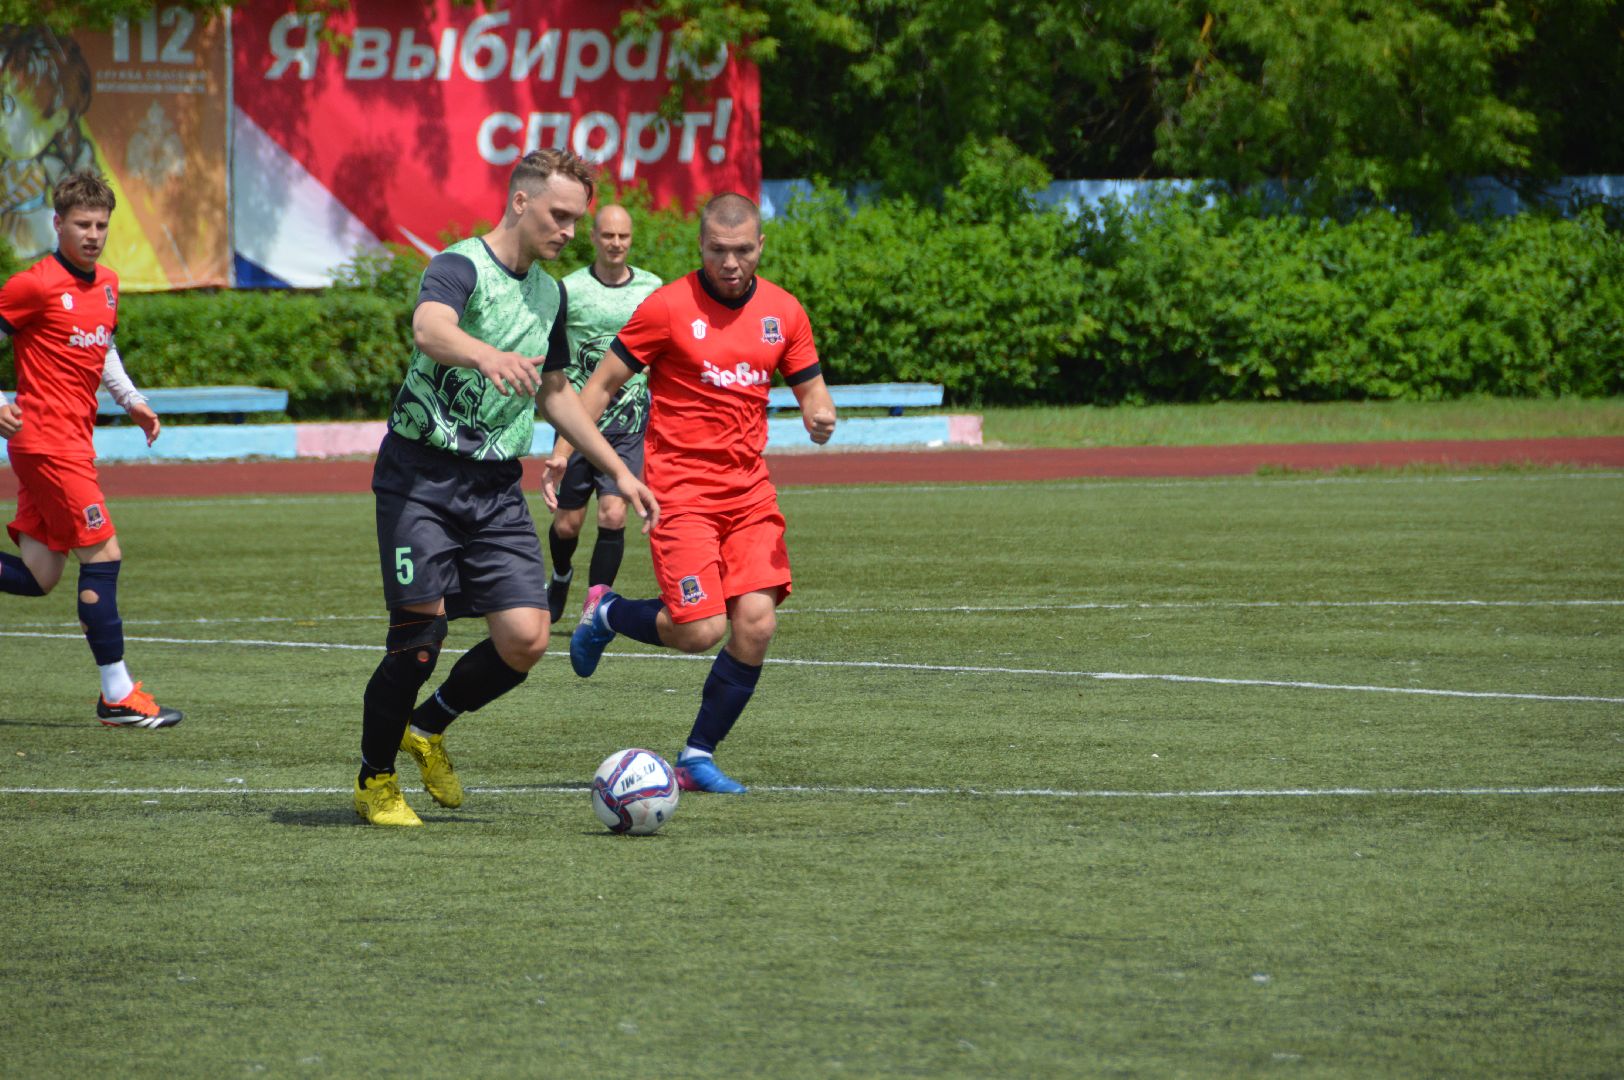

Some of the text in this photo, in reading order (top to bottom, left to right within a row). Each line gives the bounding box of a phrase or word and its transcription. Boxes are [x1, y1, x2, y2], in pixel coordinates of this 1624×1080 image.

[113, 5, 195, 63] 112
[265, 11, 322, 80] Я
[477, 98, 733, 181] спорт!
[395, 546, 414, 585] 5
